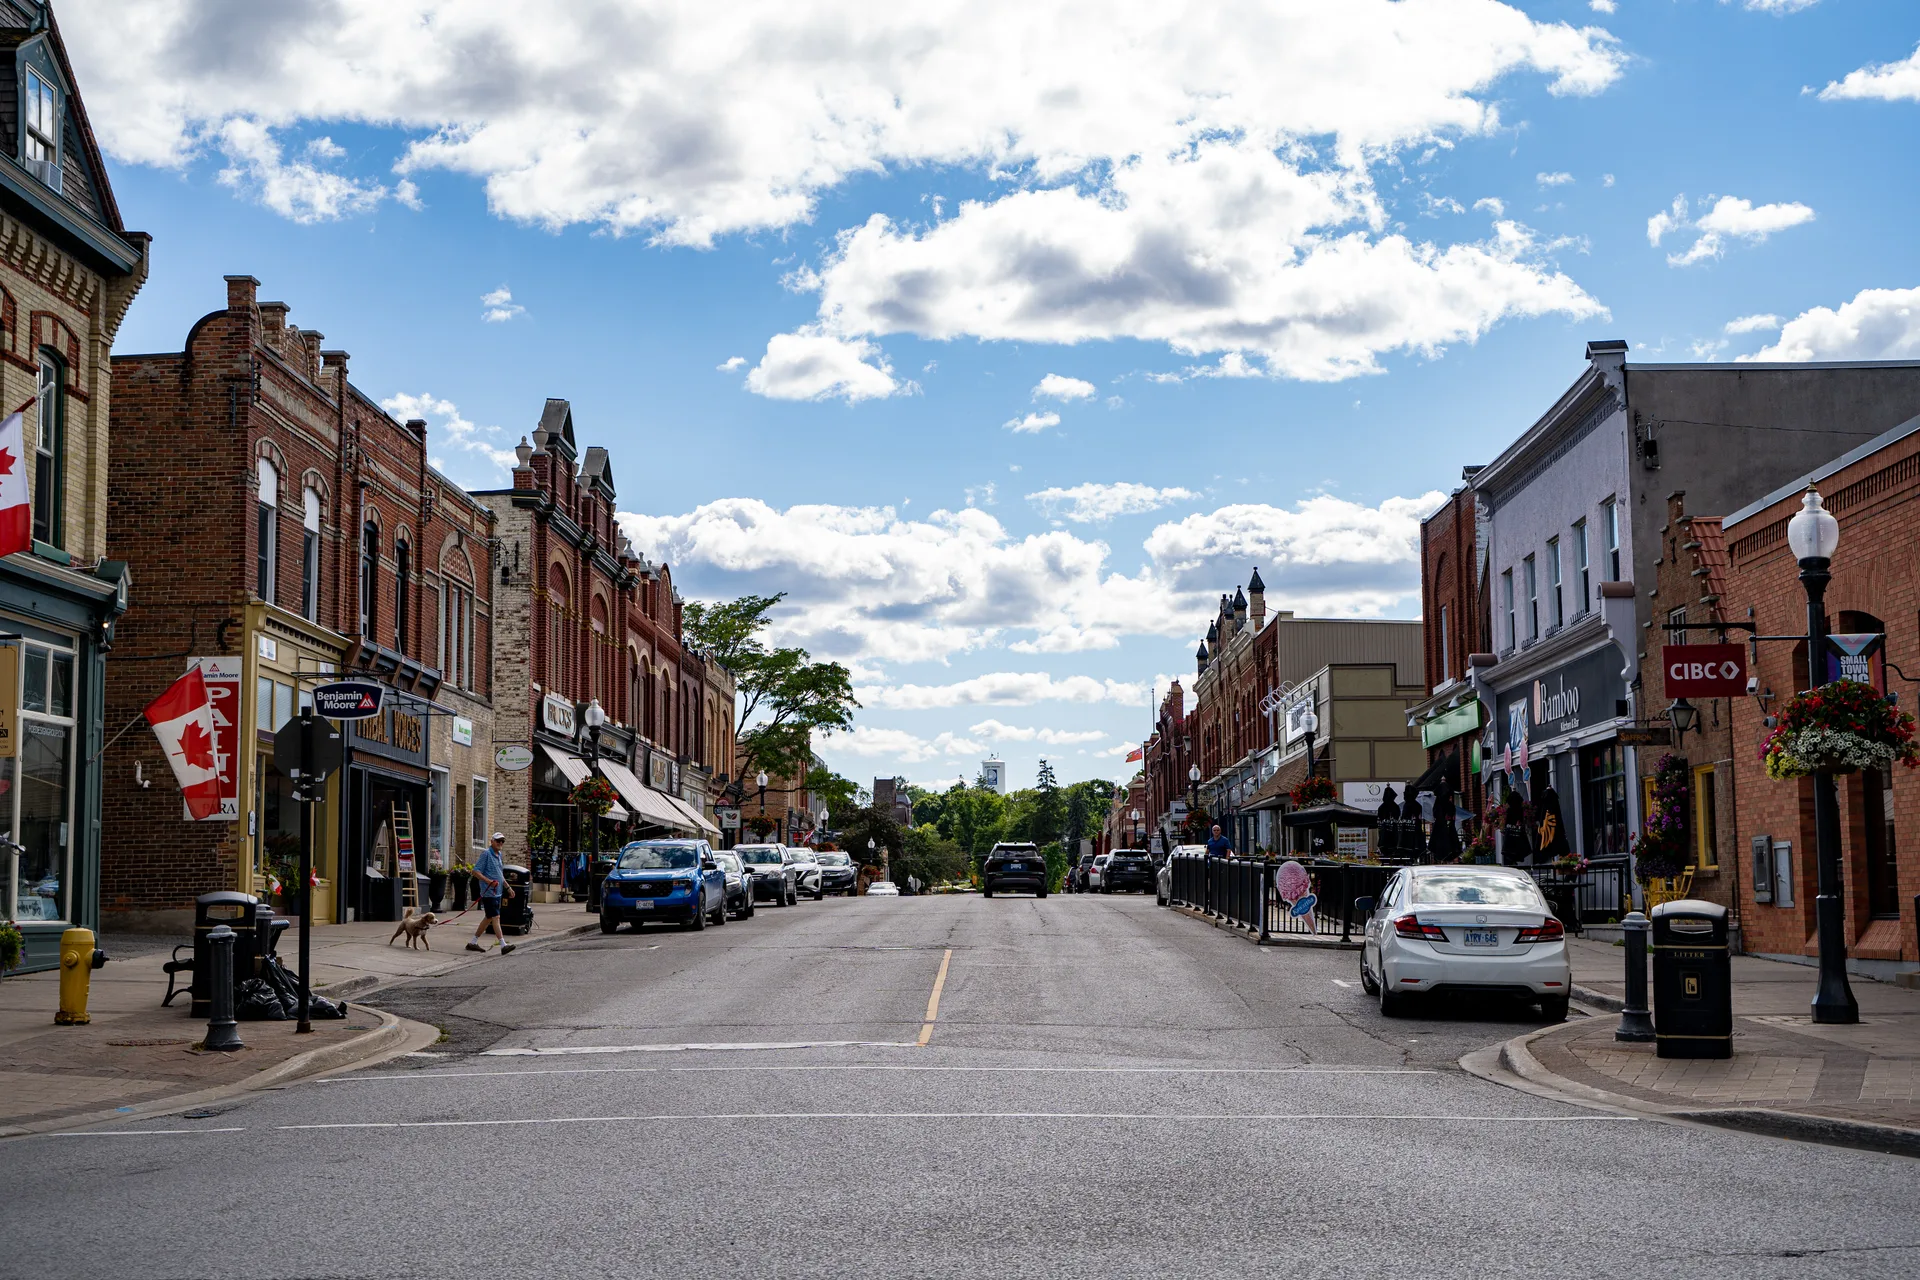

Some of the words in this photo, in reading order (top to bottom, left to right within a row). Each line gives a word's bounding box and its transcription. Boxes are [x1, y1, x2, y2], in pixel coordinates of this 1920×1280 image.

[1840, 655, 1868, 665] SMALL
[1670, 662, 1717, 680] CIBC
[1840, 664, 1868, 675] TOWN
[317, 691, 363, 703] Benjamin
[1540, 674, 1579, 724] Bamboo
[323, 700, 355, 710] Moore
[392, 709, 422, 754] VOICES
[1292, 897, 1314, 915] Kawartha
[1465, 933, 1481, 943] AYRV
[1485, 933, 1498, 943] 645
